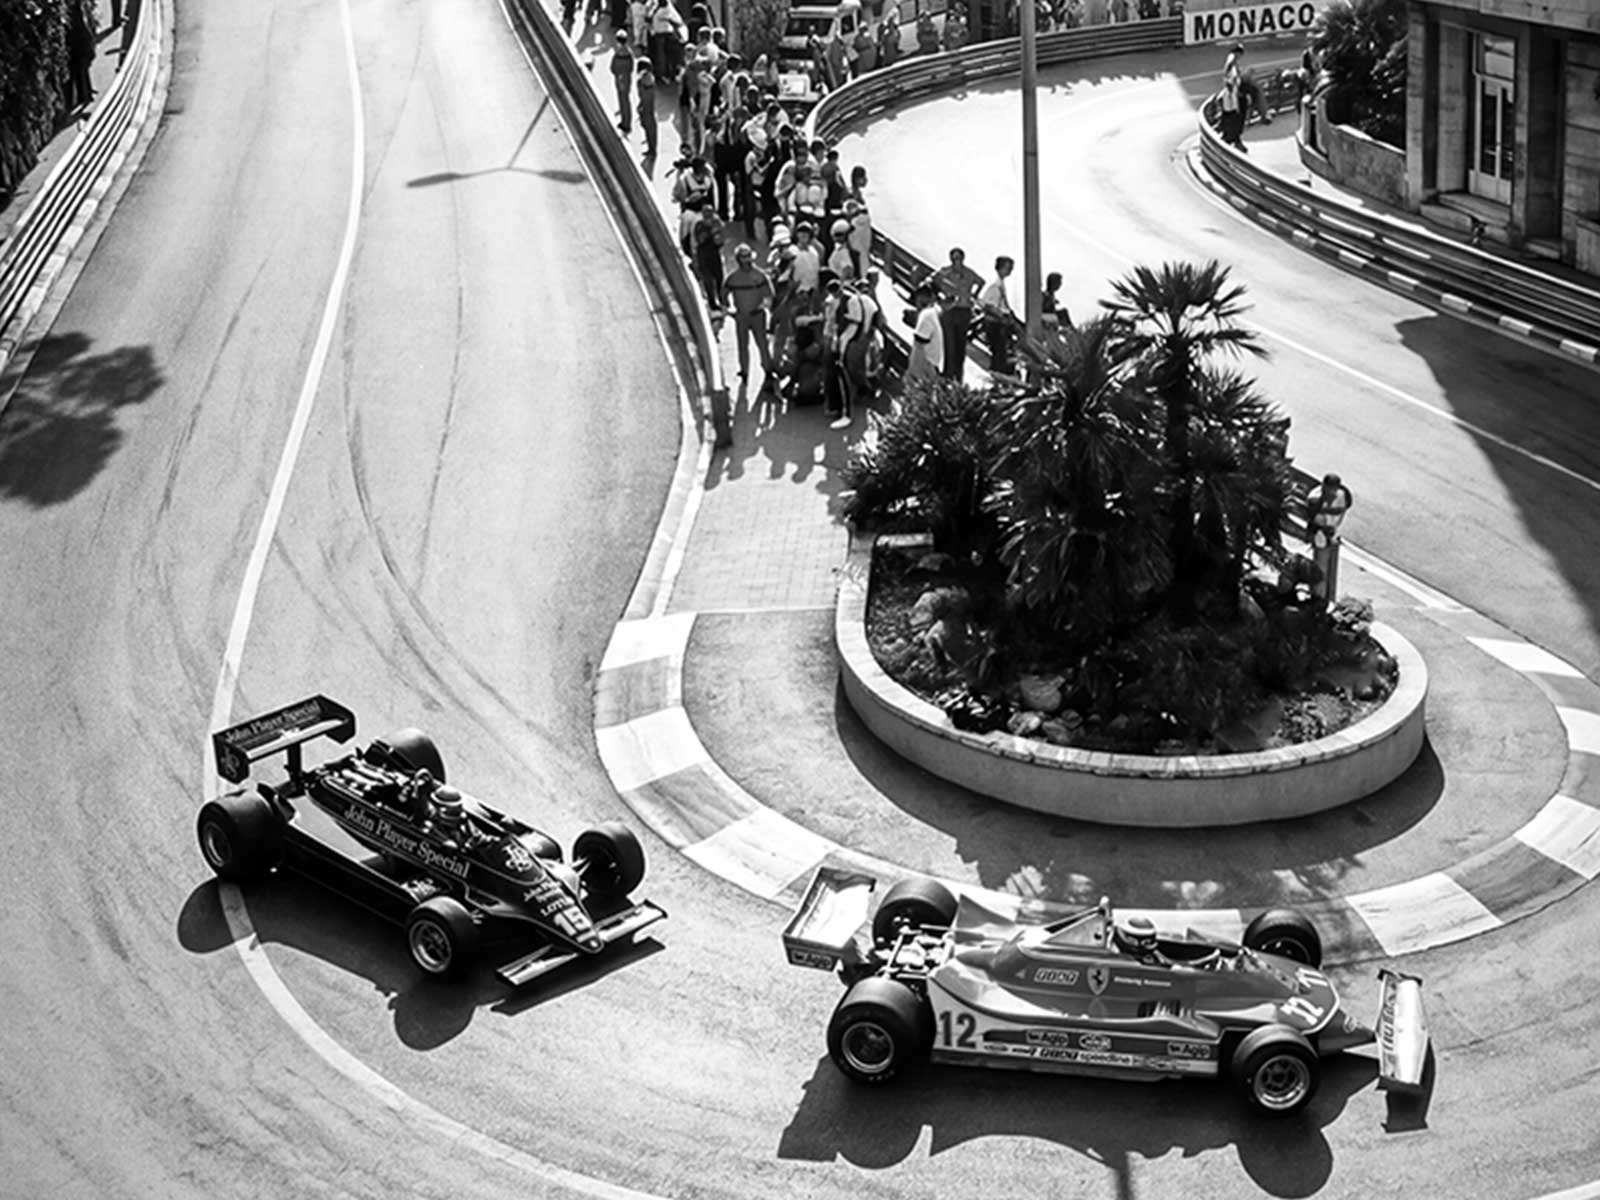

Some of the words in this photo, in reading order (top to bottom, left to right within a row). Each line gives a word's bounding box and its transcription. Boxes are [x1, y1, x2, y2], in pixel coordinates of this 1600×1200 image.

[1194, 3, 1315, 41] MONACO
[344, 804, 375, 831] John
[375, 820, 417, 851] Player
[417, 841, 470, 878] Special
[940, 1010, 977, 1049] 12
